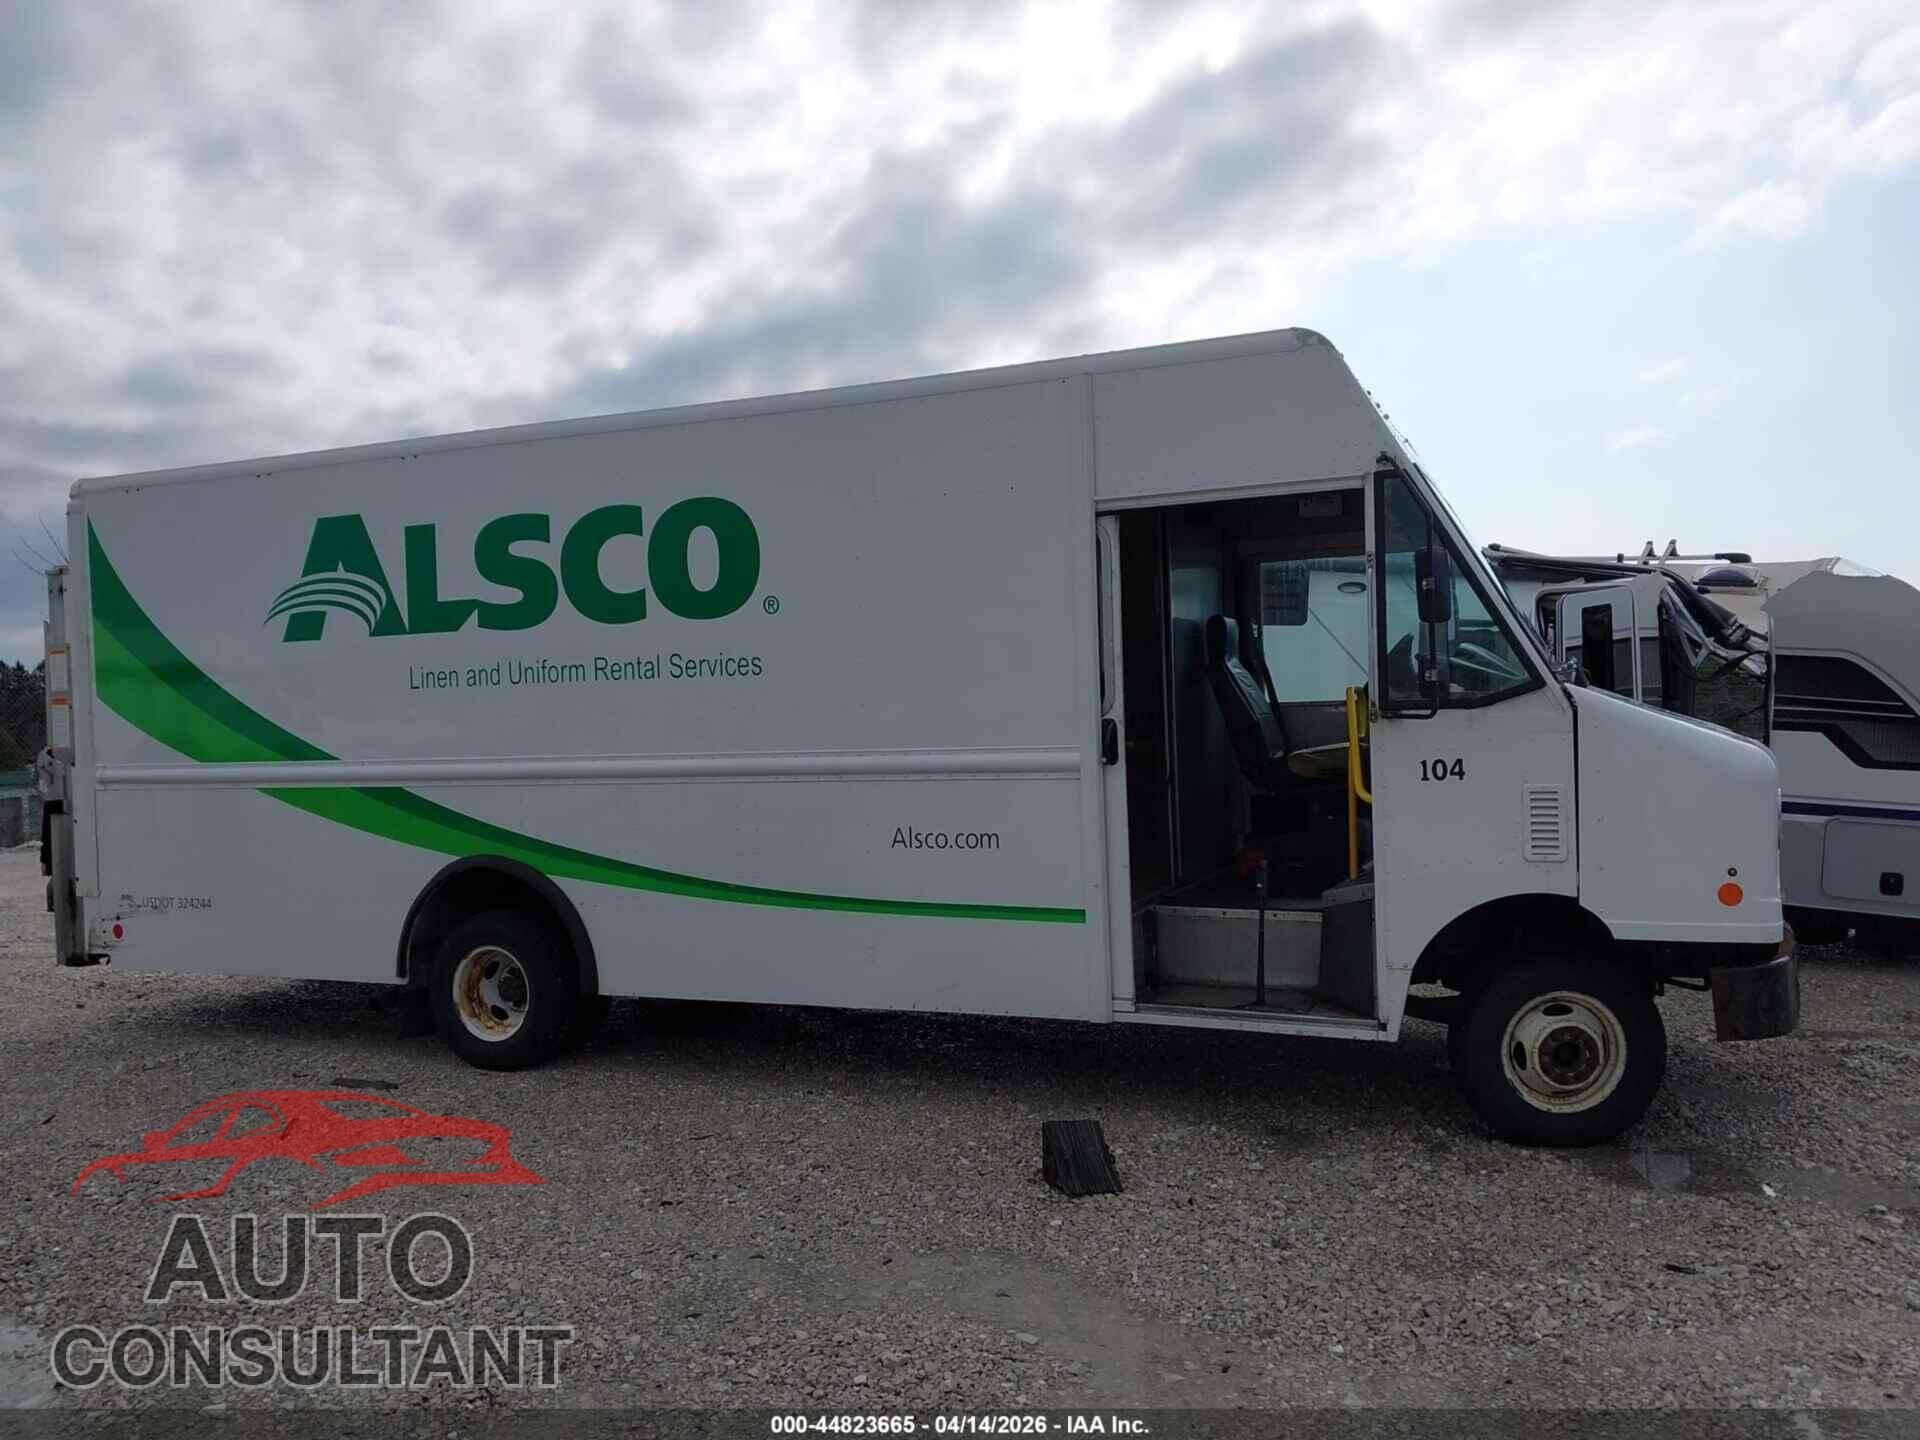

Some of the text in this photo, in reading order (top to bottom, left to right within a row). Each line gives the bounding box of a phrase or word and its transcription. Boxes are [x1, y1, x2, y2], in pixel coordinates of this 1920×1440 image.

[266, 496, 761, 642] ALSCO
[409, 651, 763, 690] Linen and Uniform Rental Services
[1420, 758, 1466, 782] 104
[891, 826, 1000, 849] Alsco.com
